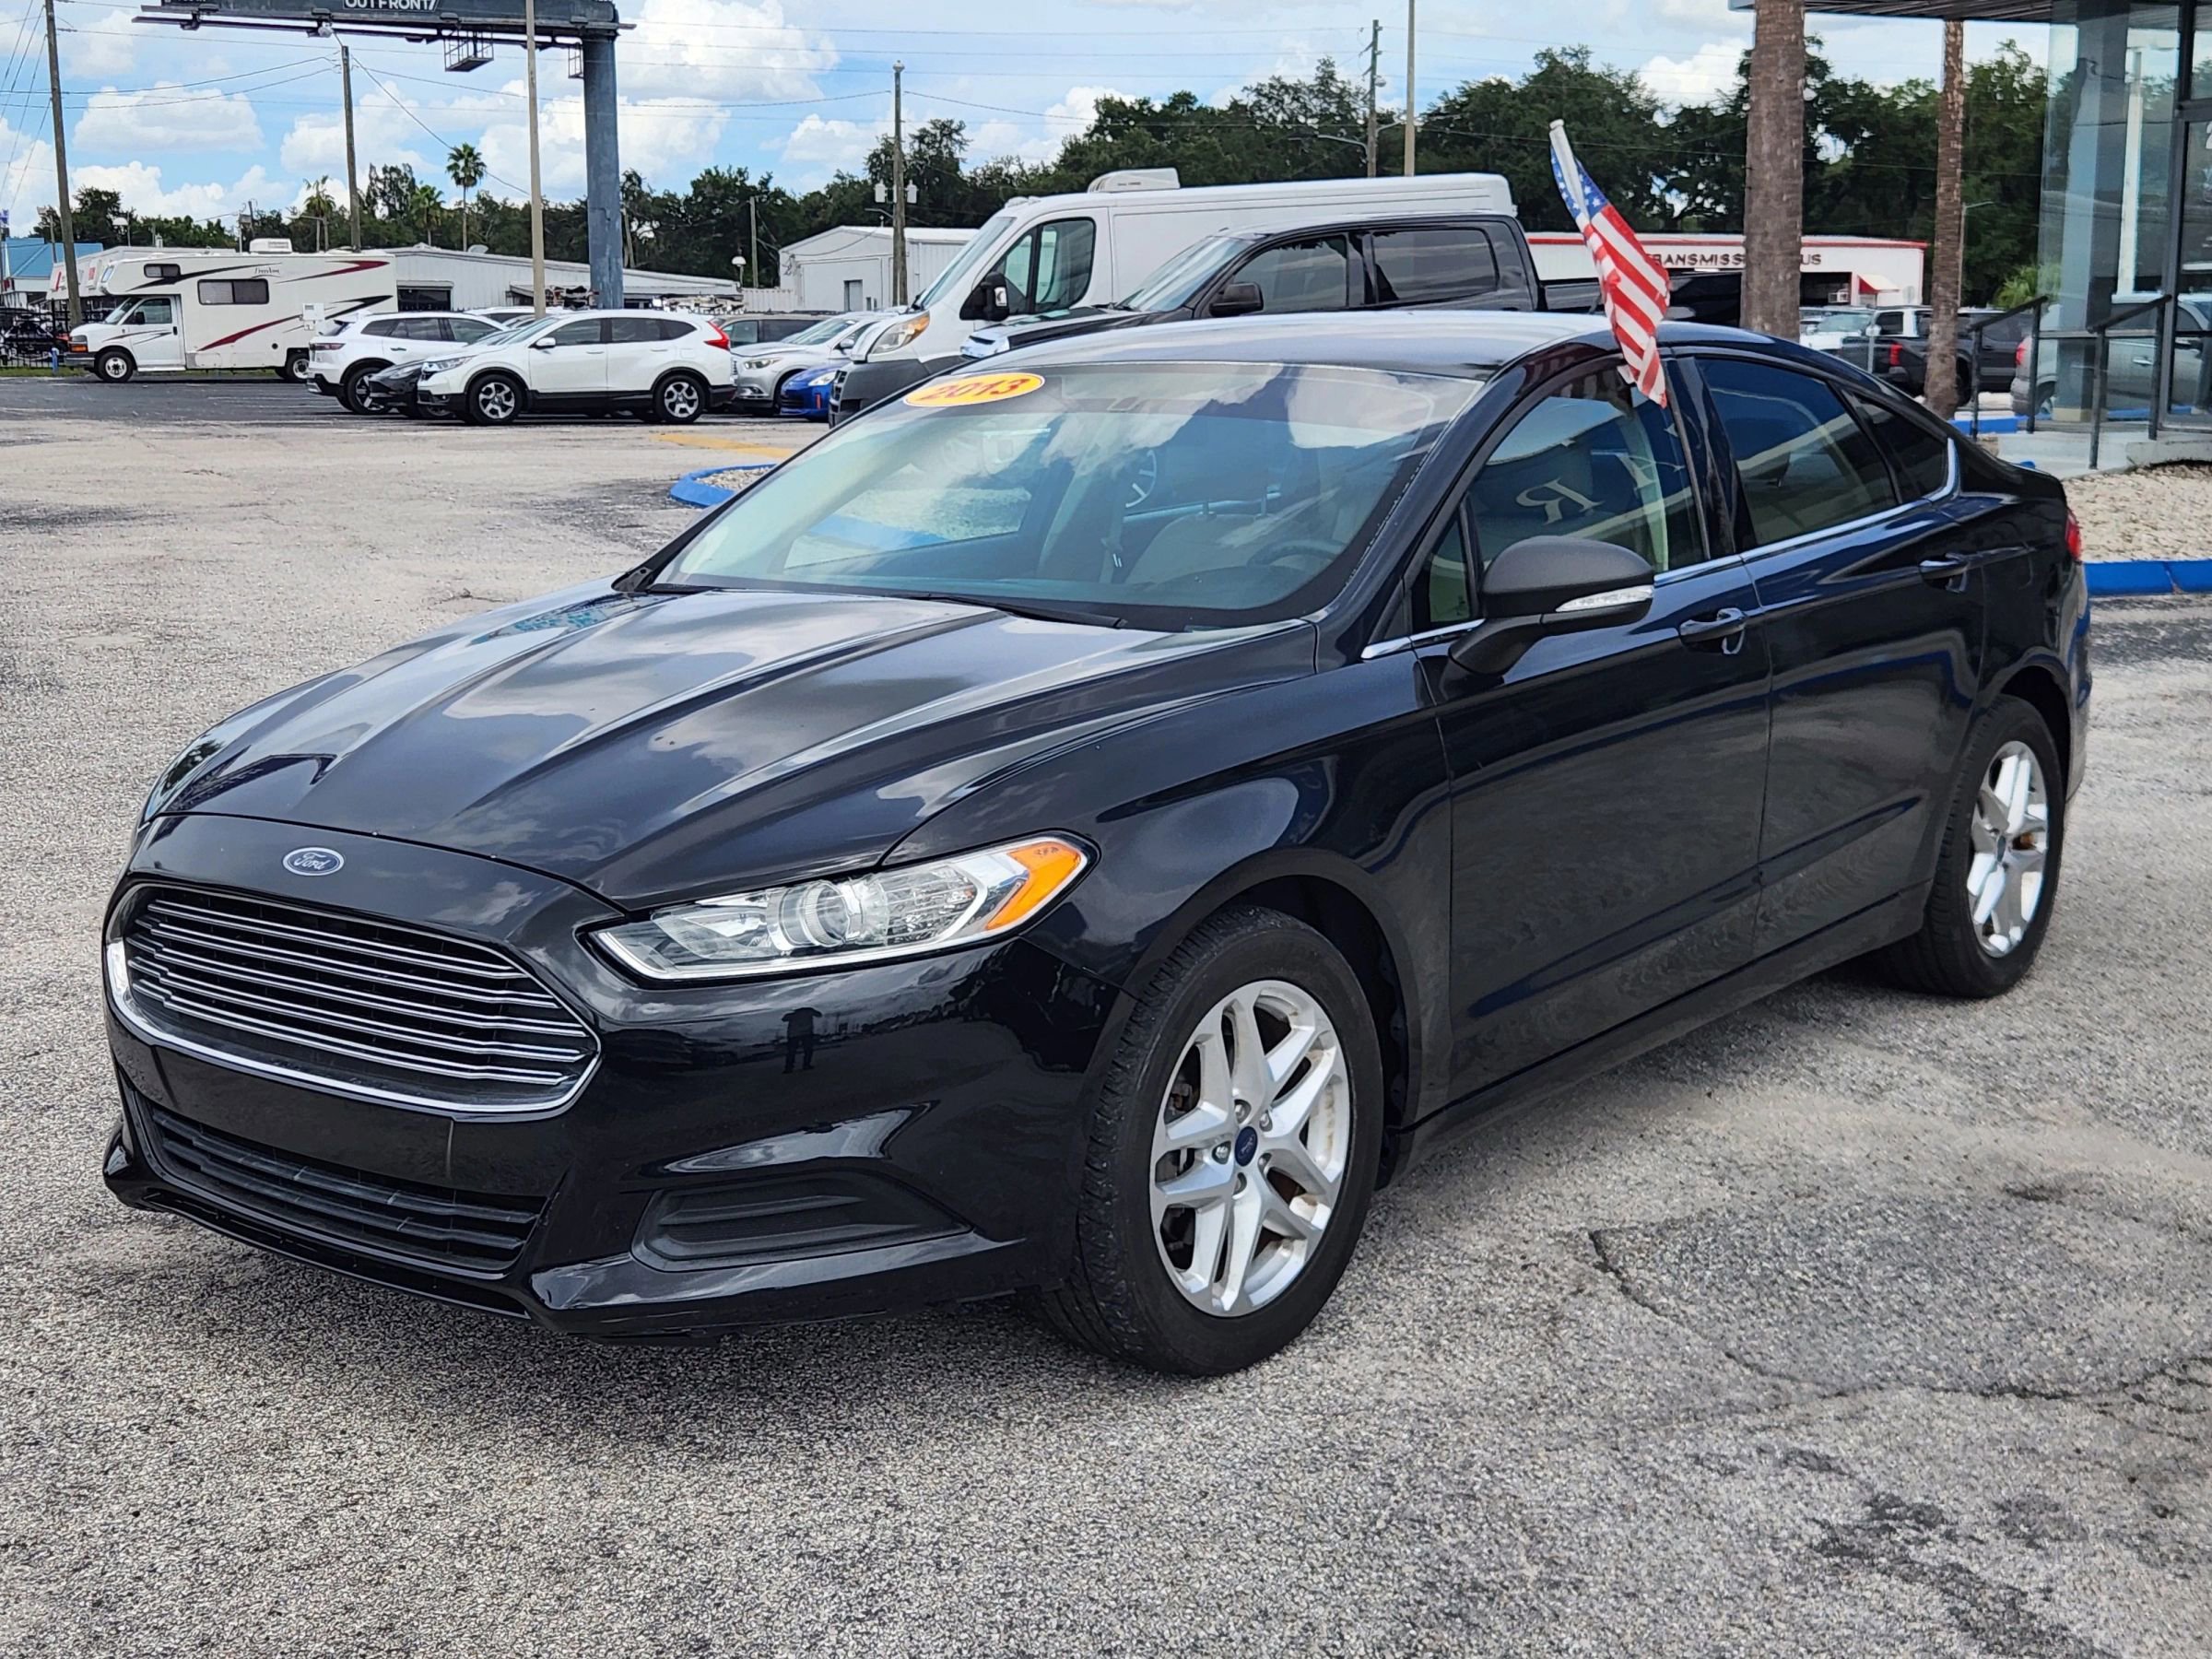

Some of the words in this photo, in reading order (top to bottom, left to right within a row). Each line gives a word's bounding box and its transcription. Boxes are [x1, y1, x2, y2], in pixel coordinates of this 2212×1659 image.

[1646, 253, 1746, 265] RANSMISS
[915, 378, 1030, 401] 2013
[293, 852, 331, 870] Ford
